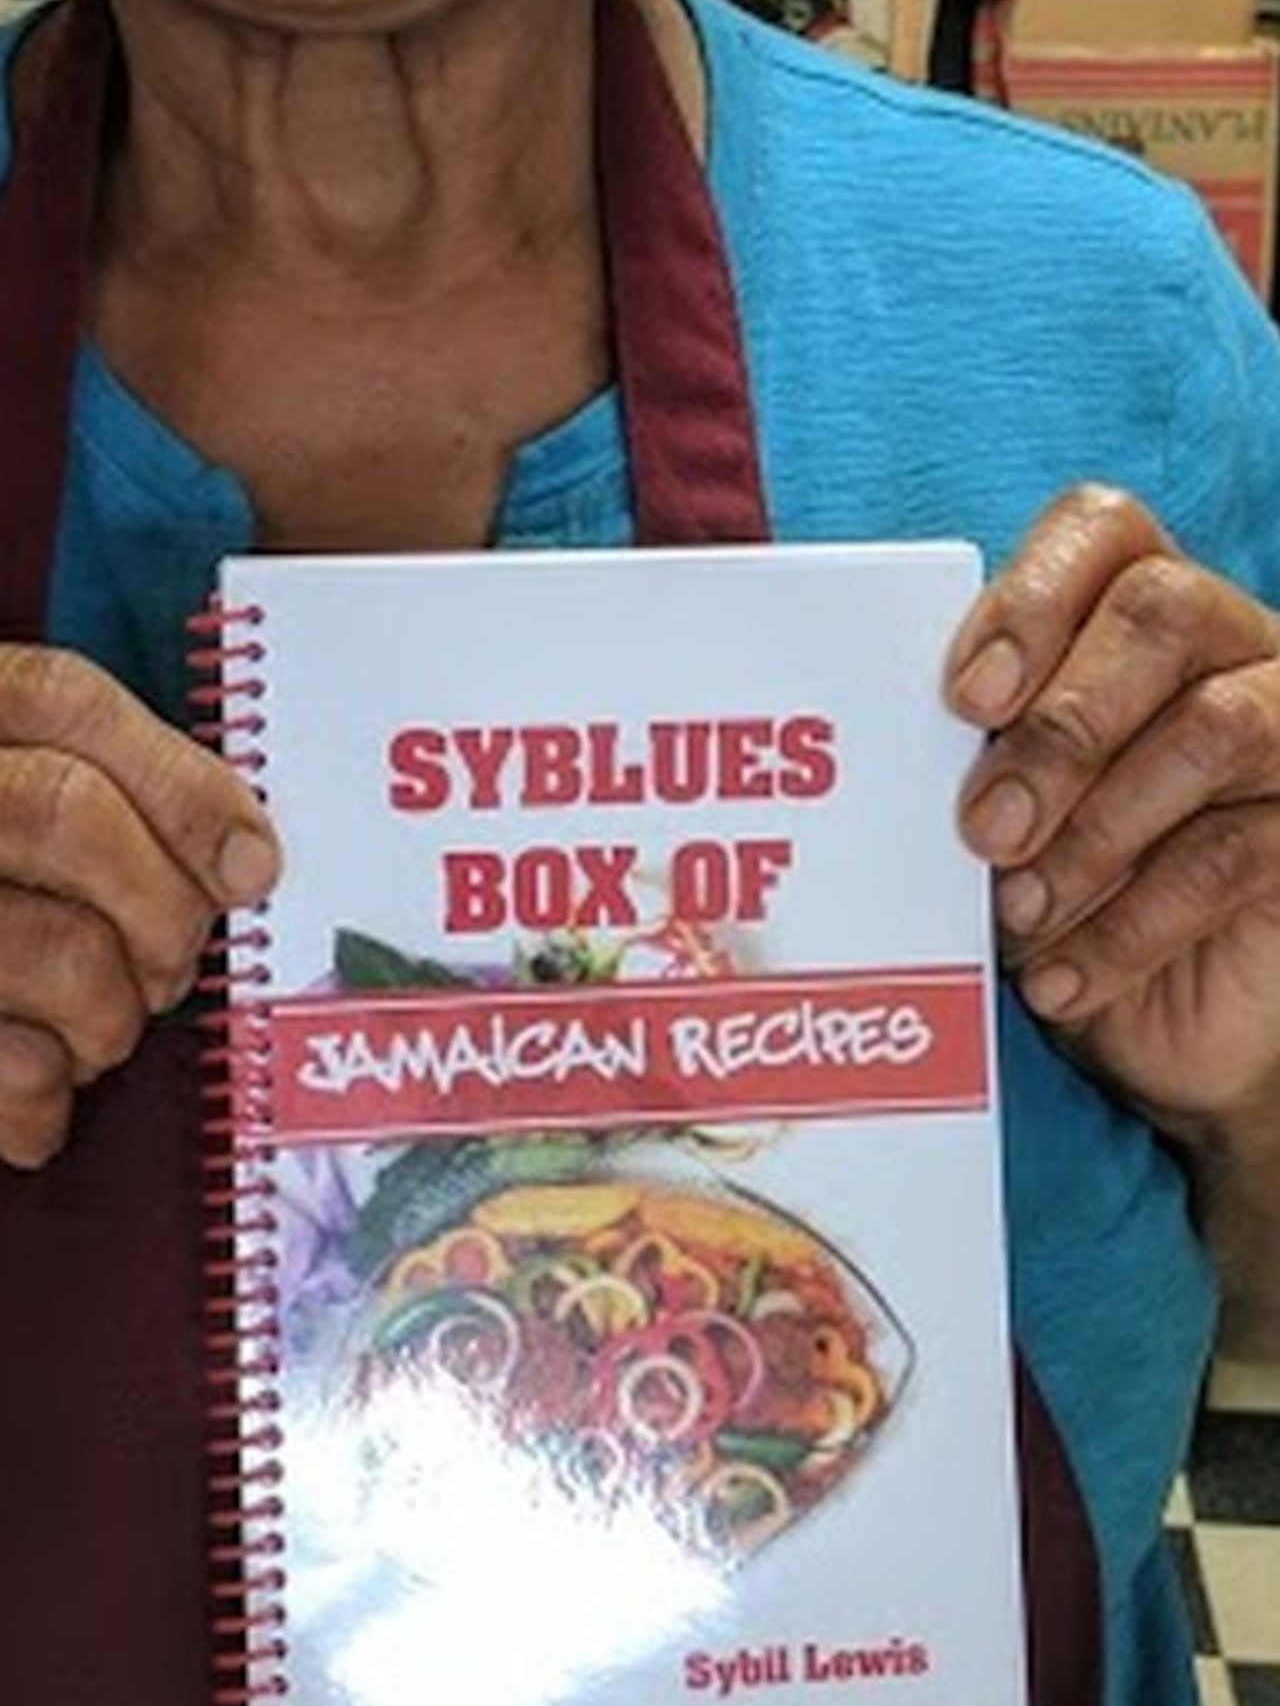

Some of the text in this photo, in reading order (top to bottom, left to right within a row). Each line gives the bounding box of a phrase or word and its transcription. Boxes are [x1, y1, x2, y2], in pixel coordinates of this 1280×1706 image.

[388, 717, 839, 815] SYBLUES
[442, 841, 792, 934] BOX OF
[297, 1001, 933, 1095] JAMAICAN RECIPES
[684, 1636, 930, 1696] Sybil Lewis
